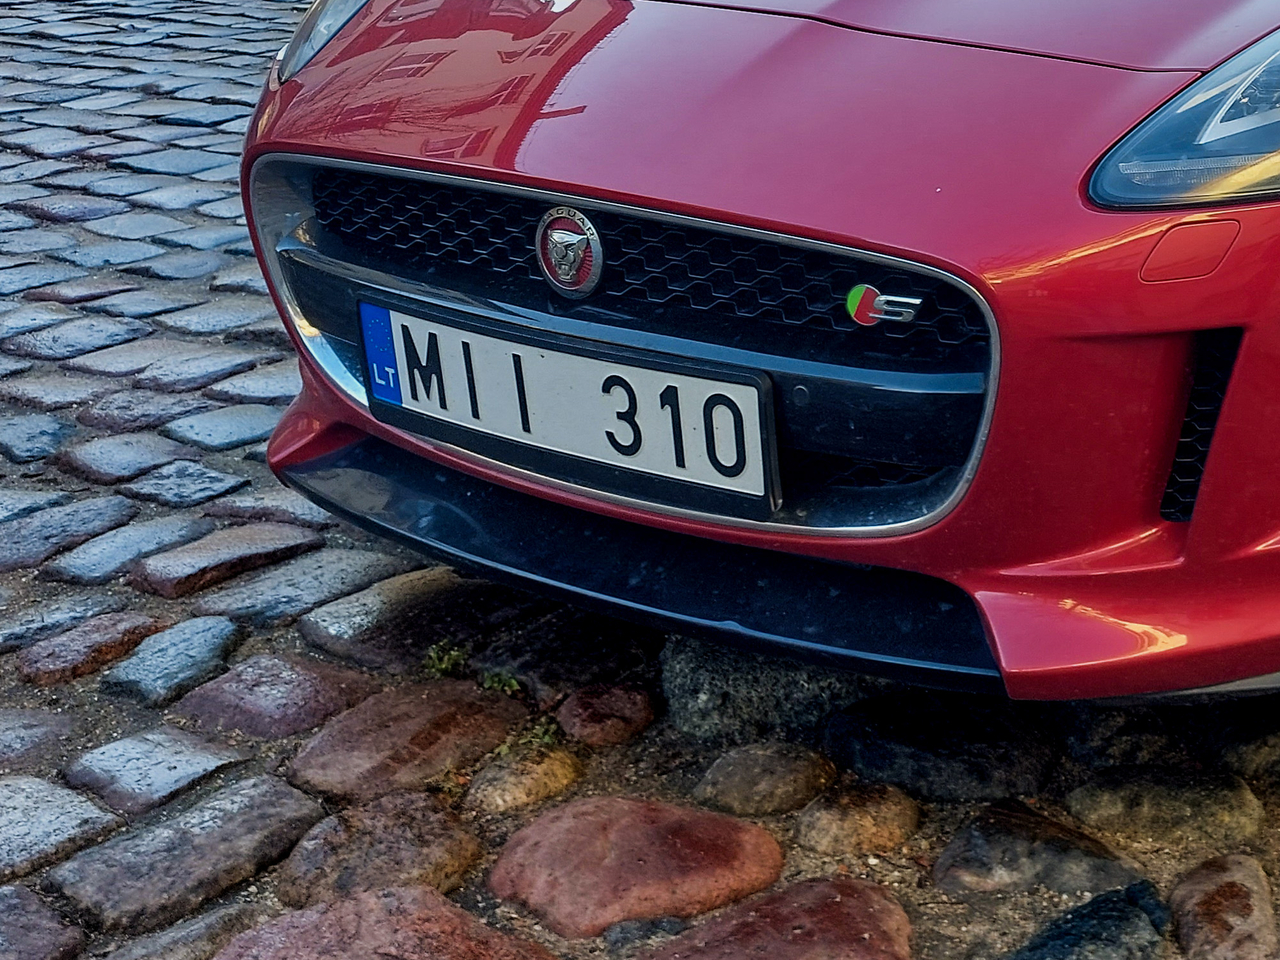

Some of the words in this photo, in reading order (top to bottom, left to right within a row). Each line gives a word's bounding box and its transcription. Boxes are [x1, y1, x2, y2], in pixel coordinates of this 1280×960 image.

[541, 207, 595, 238] JAGUAR
[373, 362, 396, 388] LT
[401, 323, 531, 433] MII
[601, 374, 747, 478] 310
